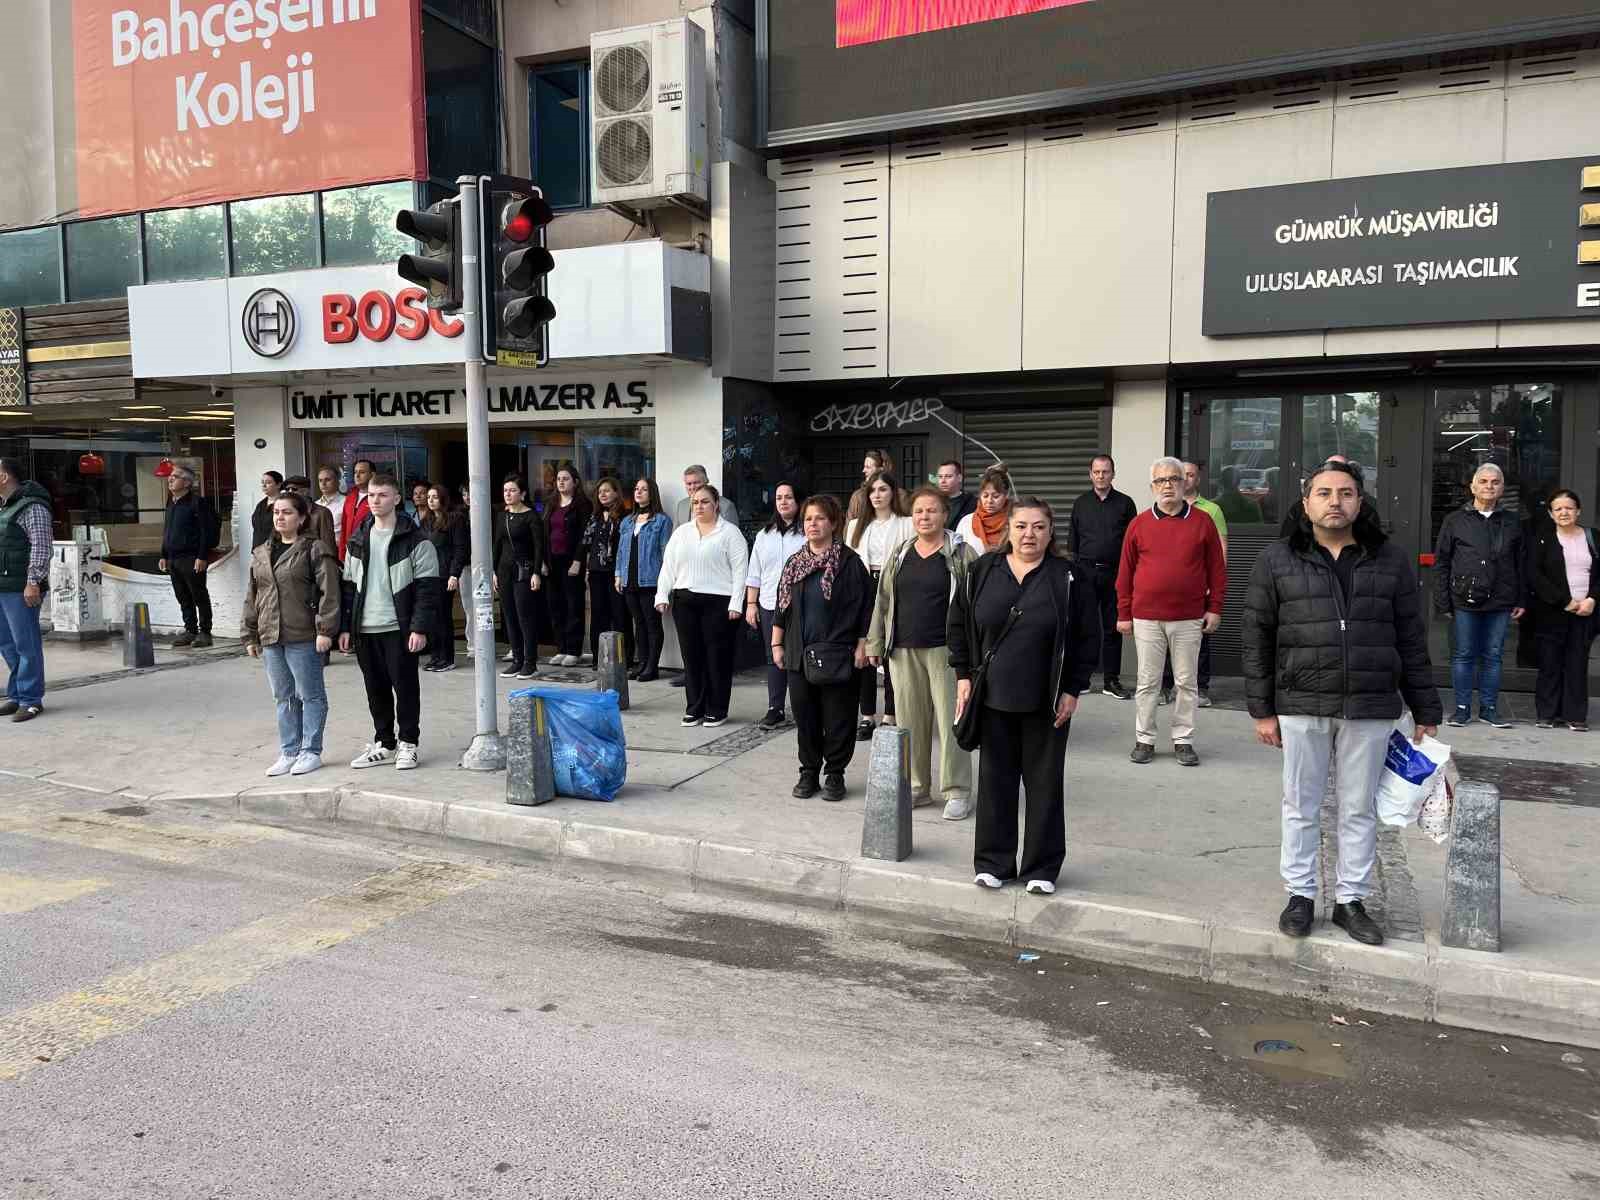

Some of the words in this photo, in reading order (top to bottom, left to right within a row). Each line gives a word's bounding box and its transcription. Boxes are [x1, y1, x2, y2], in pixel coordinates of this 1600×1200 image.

[176, 52, 315, 134] Koleji
[1275, 215, 1364, 244] GÜMRÜK
[1368, 202, 1499, 237] MÜŞAVİRLİĞİ
[1246, 265, 1383, 293] ULUSLARARASI
[1393, 256, 1519, 286] TAŞIMACILIK
[291, 390, 348, 419] ÜMİT
[353, 388, 455, 417] TİCARET
[602, 381, 654, 414] A.Ş.
